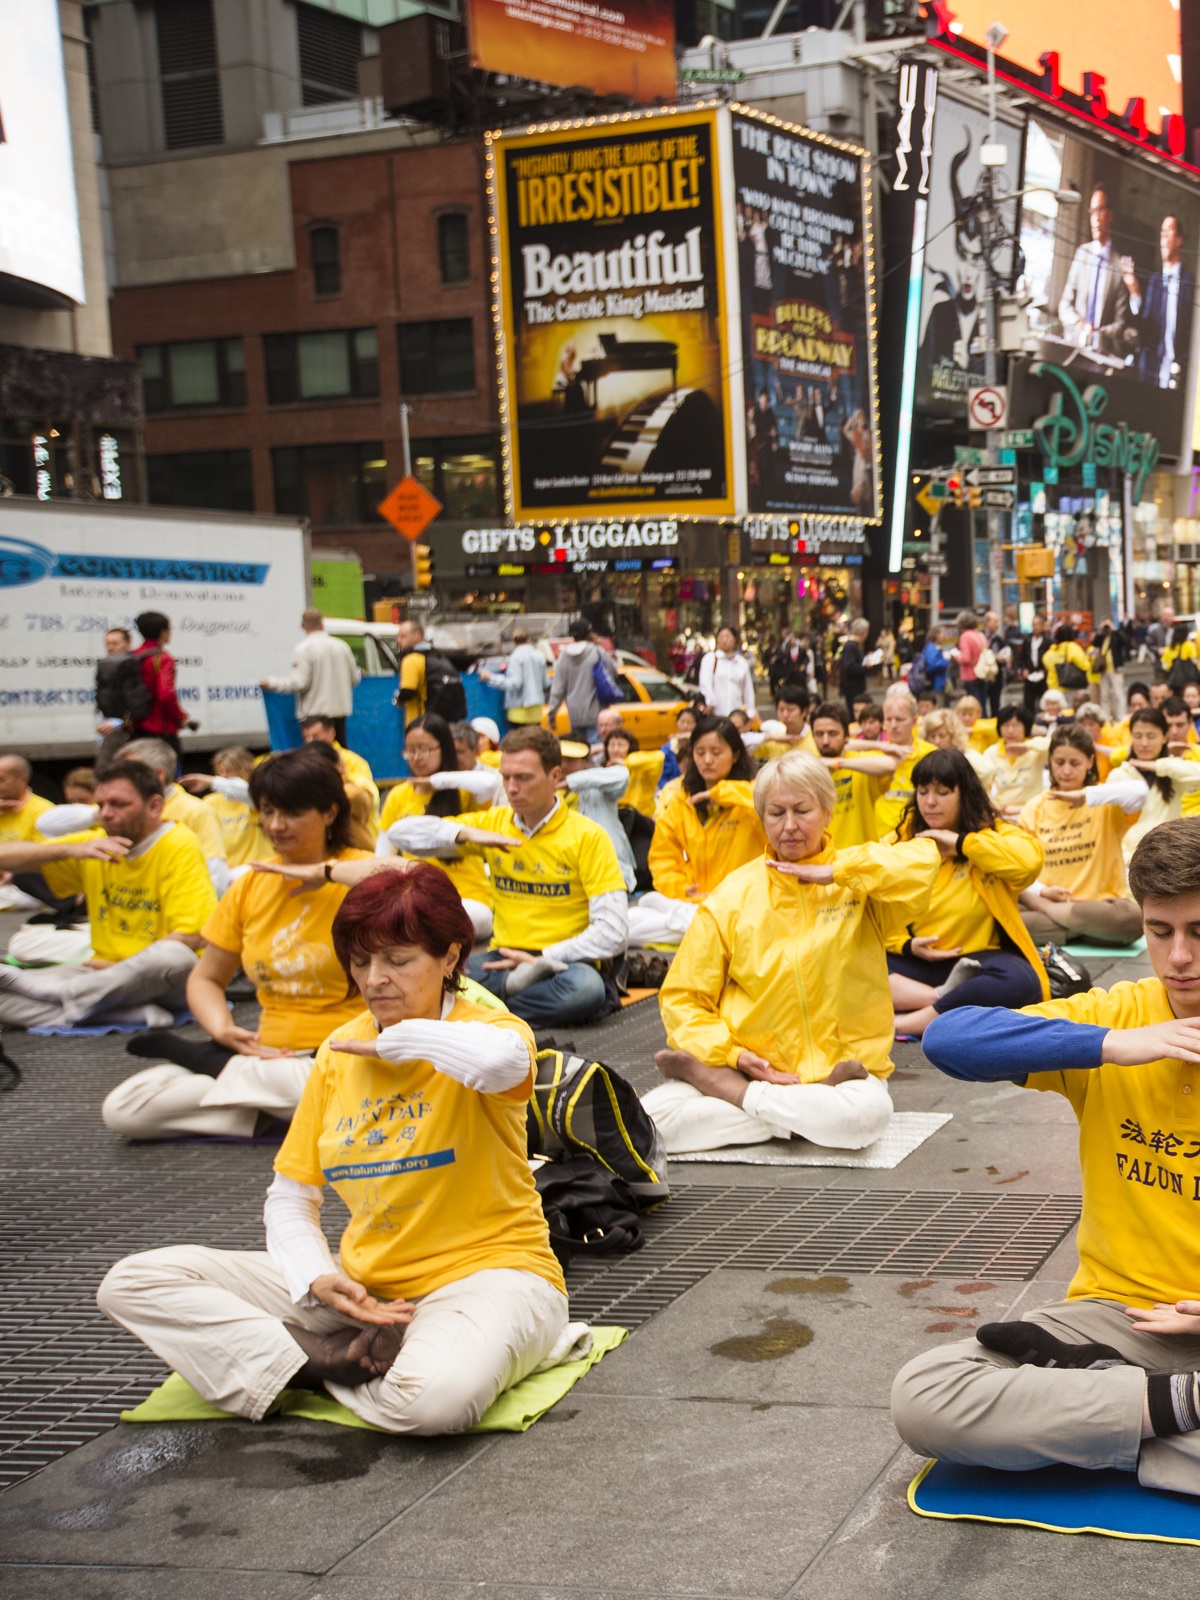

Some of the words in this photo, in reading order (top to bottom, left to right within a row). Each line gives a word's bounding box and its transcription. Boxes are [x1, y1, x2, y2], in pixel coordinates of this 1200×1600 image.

[521, 226, 704, 298] Beautiful
[524, 300, 555, 325] The
[555, 295, 606, 322] Carole
[605, 292, 644, 320] King
[644, 285, 705, 314] Musical
[755, 326, 853, 368] BROADWAY
[461, 528, 536, 554] GIFTS
[553, 521, 679, 550] LUGGAGE
[743, 518, 790, 541] GIFTS
[799, 519, 866, 543] LUGGAGE
[60, 557, 259, 584] CONTRACTING
[208, 685, 265, 701] SERVICE
[533, 883, 567, 895] DAFA
[330, 1158, 429, 1178] www.falundafa.org
[1115, 1152, 1184, 1196] FALUN
